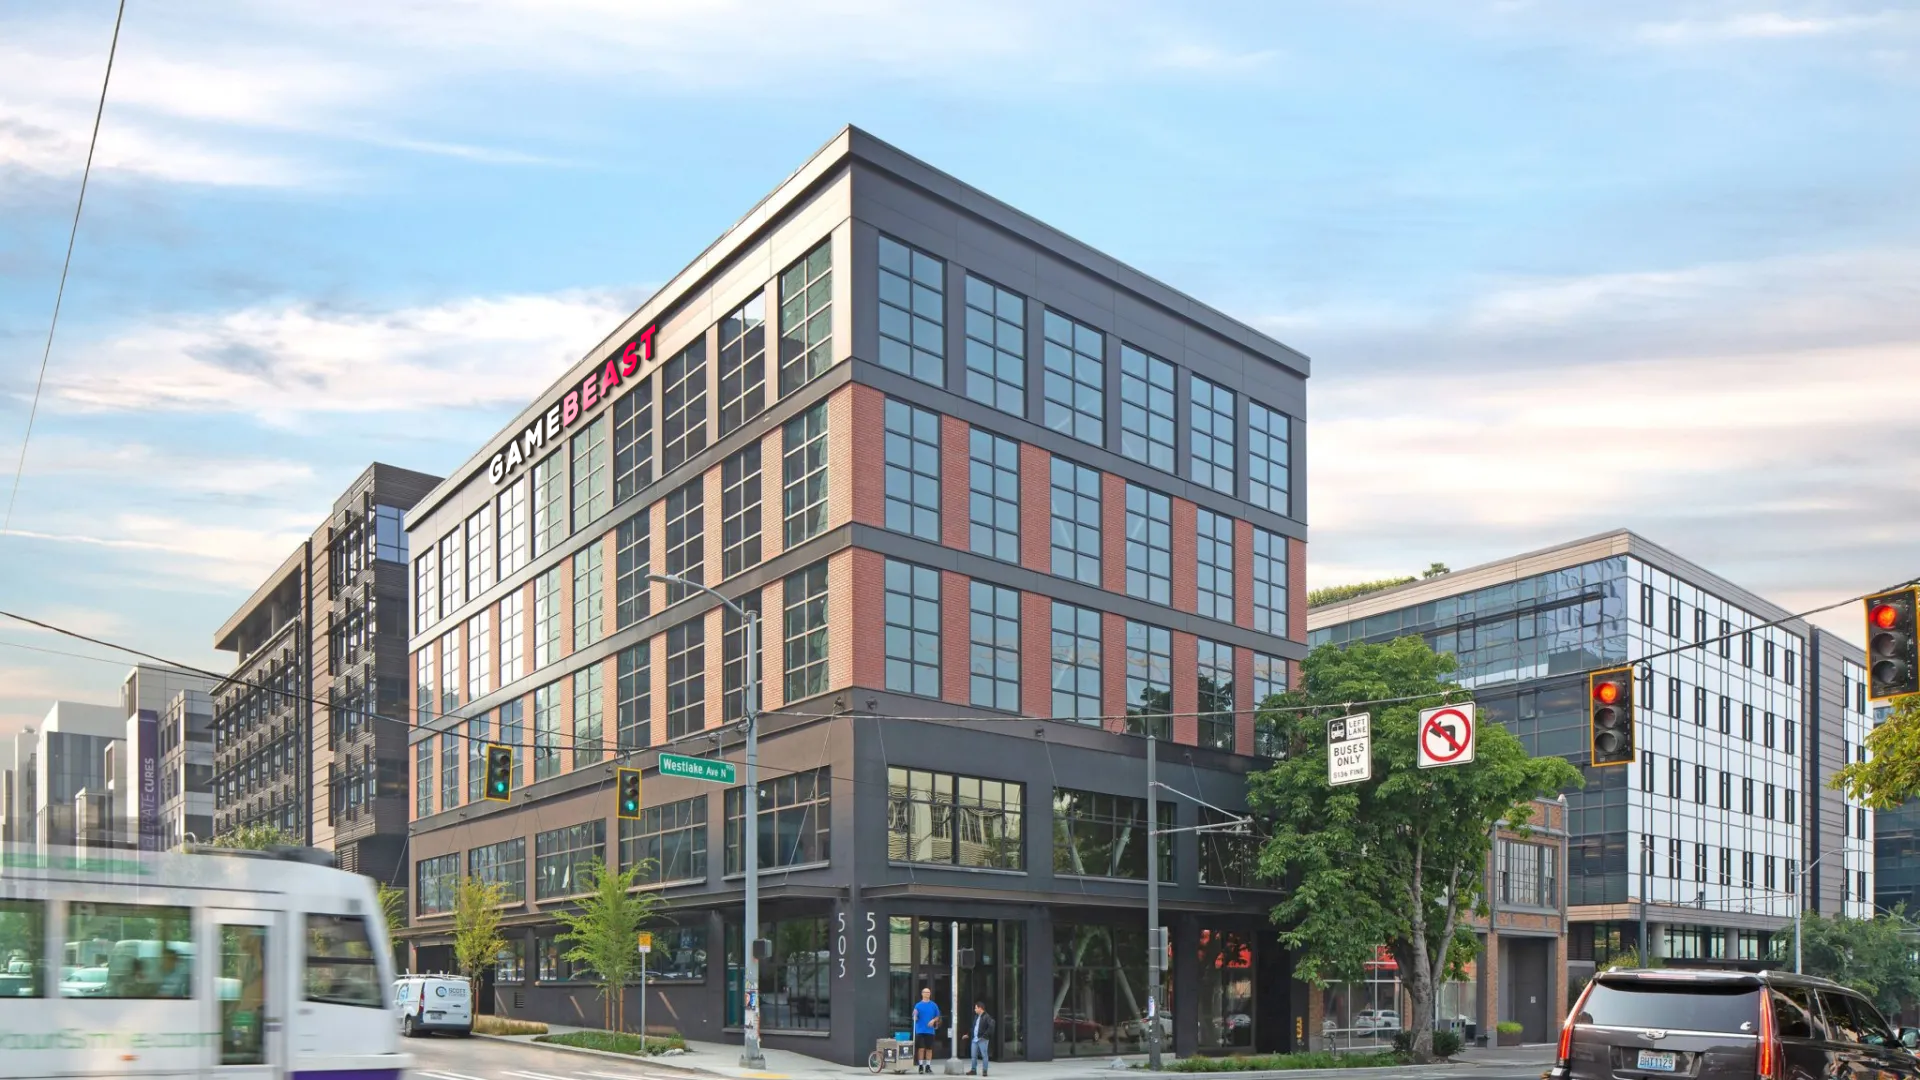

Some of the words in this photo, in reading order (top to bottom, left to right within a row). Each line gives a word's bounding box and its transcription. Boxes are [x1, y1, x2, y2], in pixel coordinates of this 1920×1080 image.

[488, 323, 656, 485] GAMEBEAST
[1348, 719, 1365, 728] LEFT
[1348, 726, 1367, 736] LANE
[1333, 743, 1365, 757] BUSES
[663, 757, 703, 775] Westlake
[706, 766, 719, 777] Ave
[720, 768, 727, 778] N
[1337, 754, 1361, 767] ONLY
[144, 757, 155, 793] CURES
[1349, 767, 1364, 776] FINE
[838, 912, 846, 978] 503
[866, 911, 877, 978] 503
